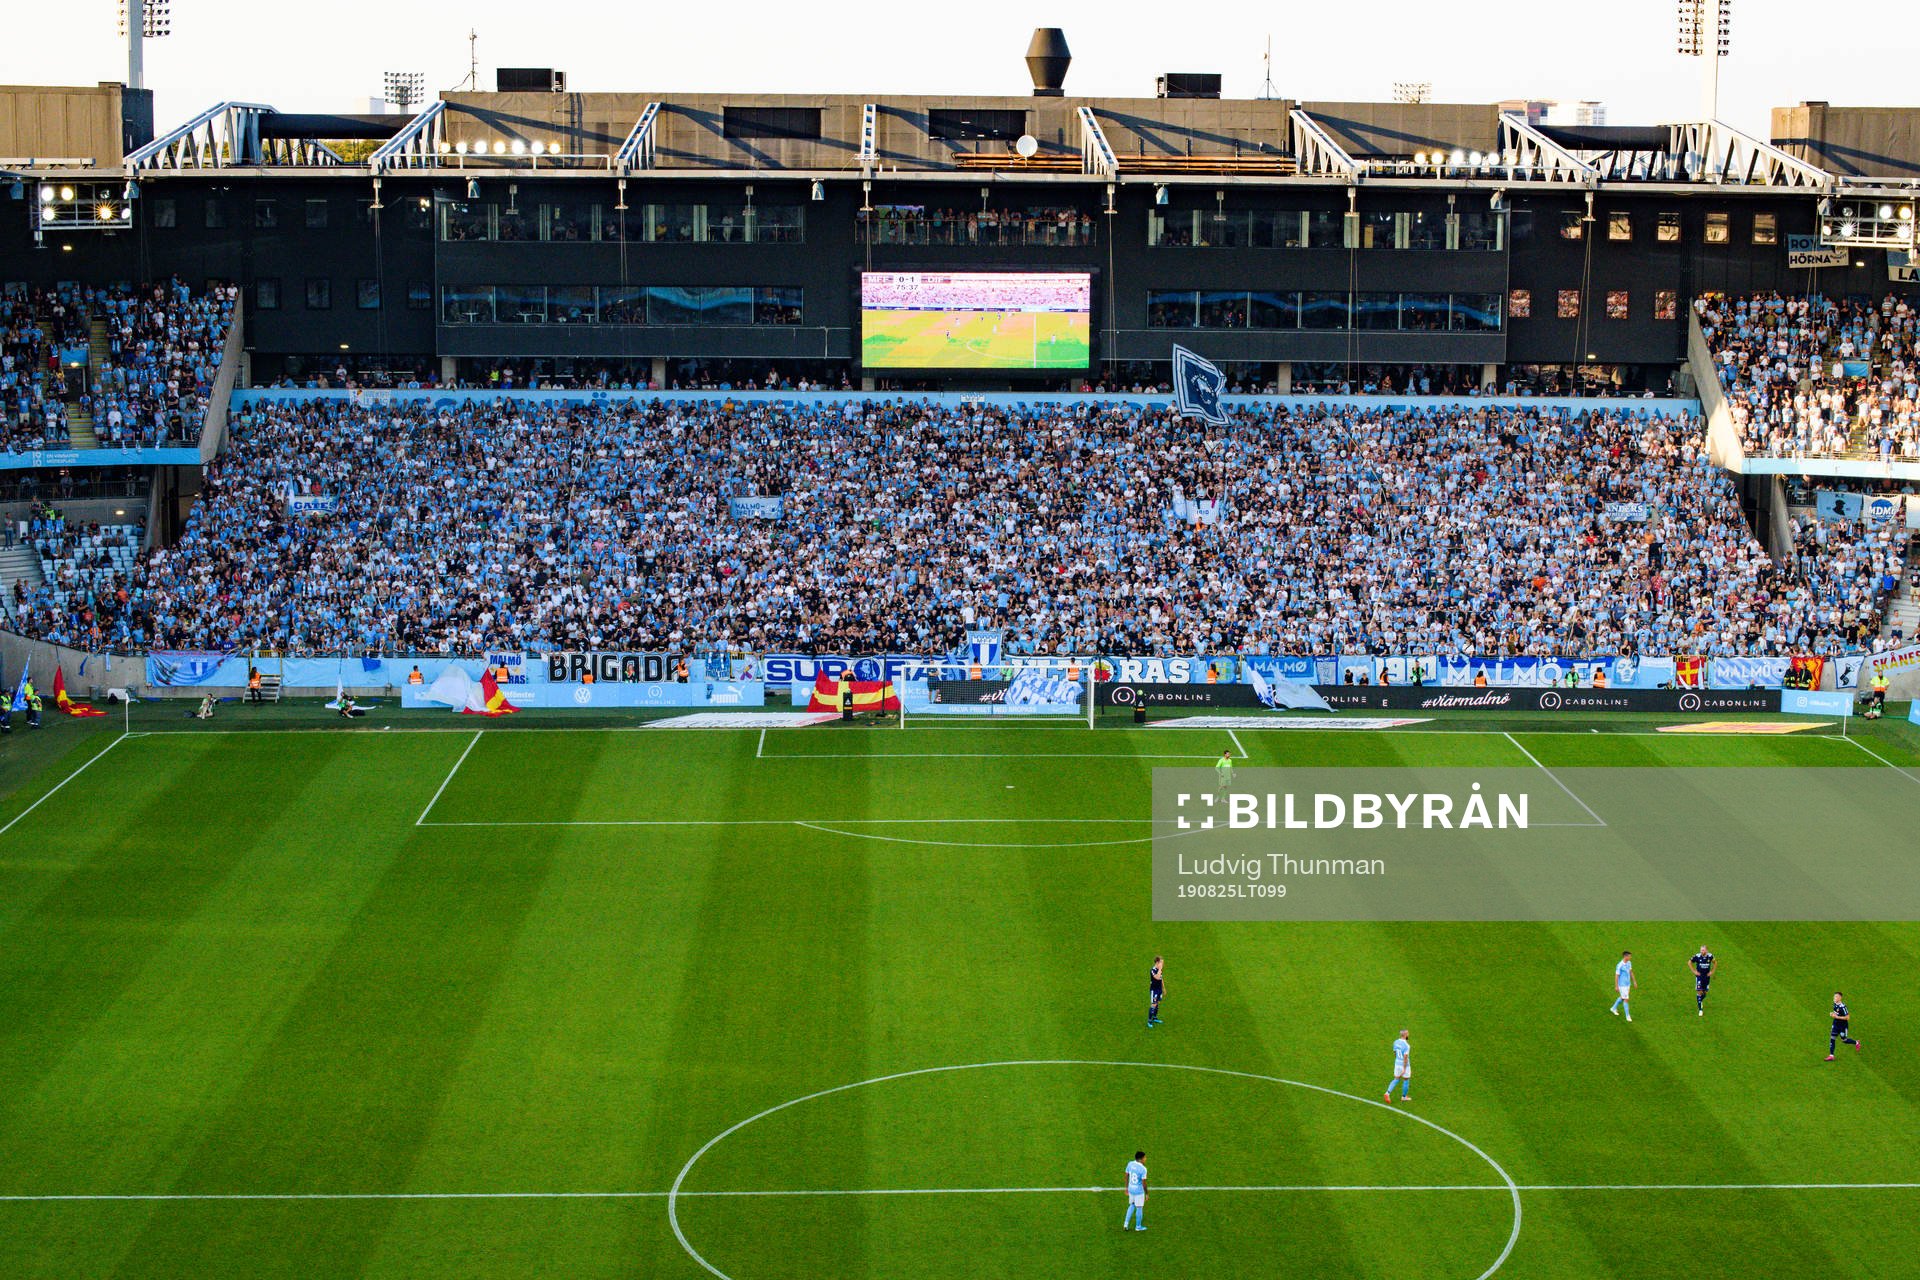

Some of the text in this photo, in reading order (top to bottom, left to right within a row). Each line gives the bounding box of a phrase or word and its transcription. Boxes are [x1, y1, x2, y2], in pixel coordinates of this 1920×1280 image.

[1790, 253, 1831, 264] HÖRNA
[1446, 657, 1562, 686] MALMÖ
[1717, 662, 1771, 678] MALMÖ
[1421, 689, 1512, 708] #viärmalmö
[1565, 698, 1628, 706] CABONLINE
[1704, 699, 1767, 707] CABONLINE
